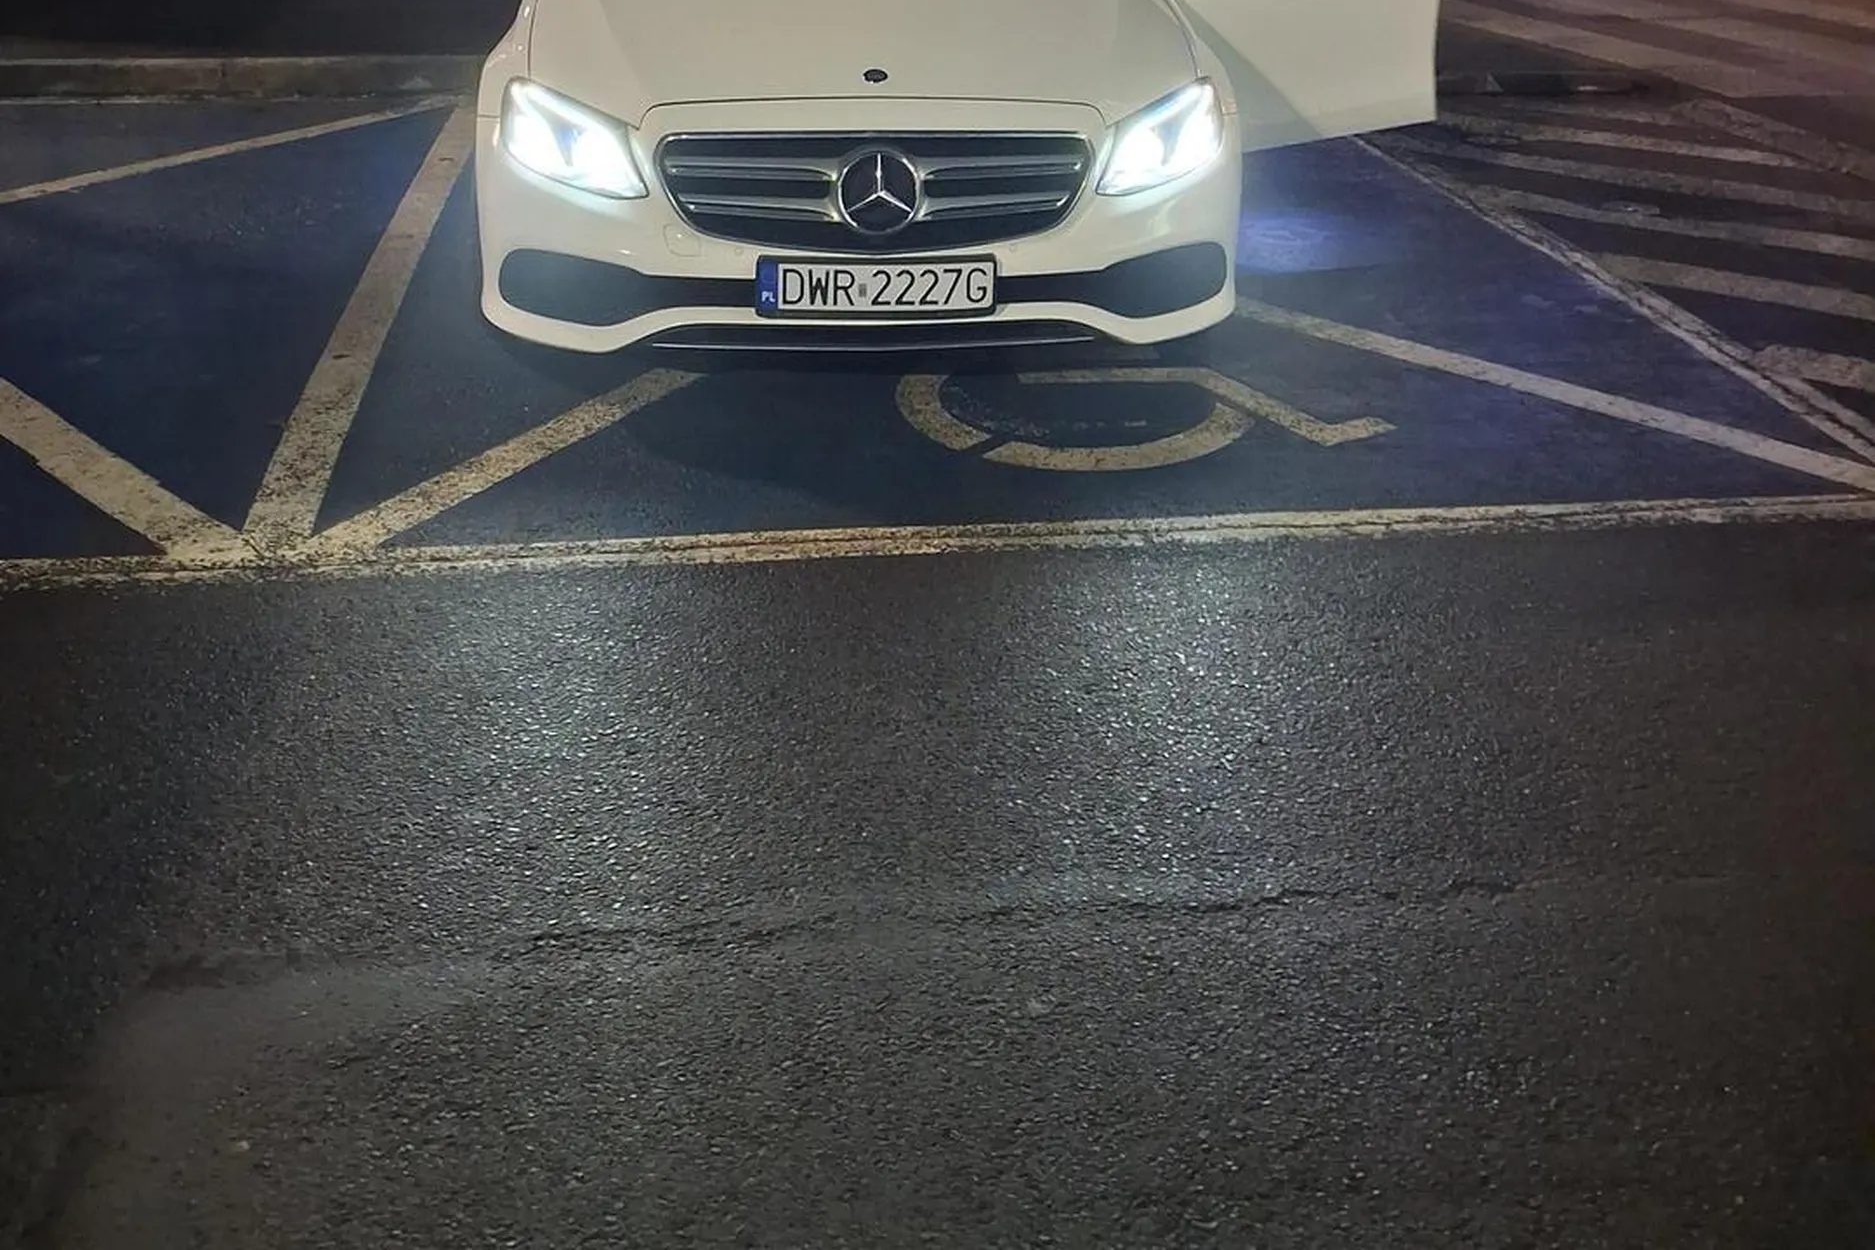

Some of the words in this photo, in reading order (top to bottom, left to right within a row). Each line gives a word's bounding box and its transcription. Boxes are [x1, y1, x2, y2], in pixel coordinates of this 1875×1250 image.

[761, 291, 775, 302] PL
[782, 269, 856, 306] DWR
[870, 268, 989, 306] 2227G
